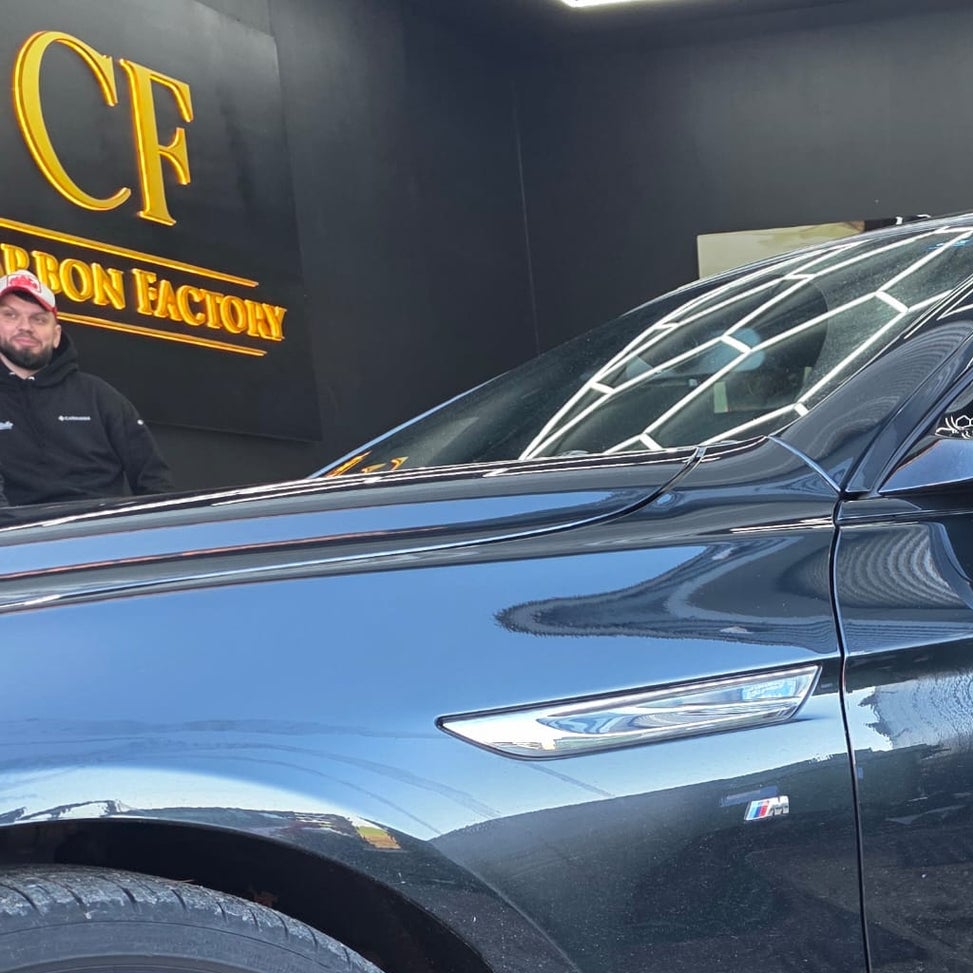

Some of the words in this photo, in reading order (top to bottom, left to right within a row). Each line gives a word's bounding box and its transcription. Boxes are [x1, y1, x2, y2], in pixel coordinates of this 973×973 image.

[13, 30, 193, 226] CF
[0, 243, 126, 310] RBON
[131, 267, 287, 341] FACTORY
